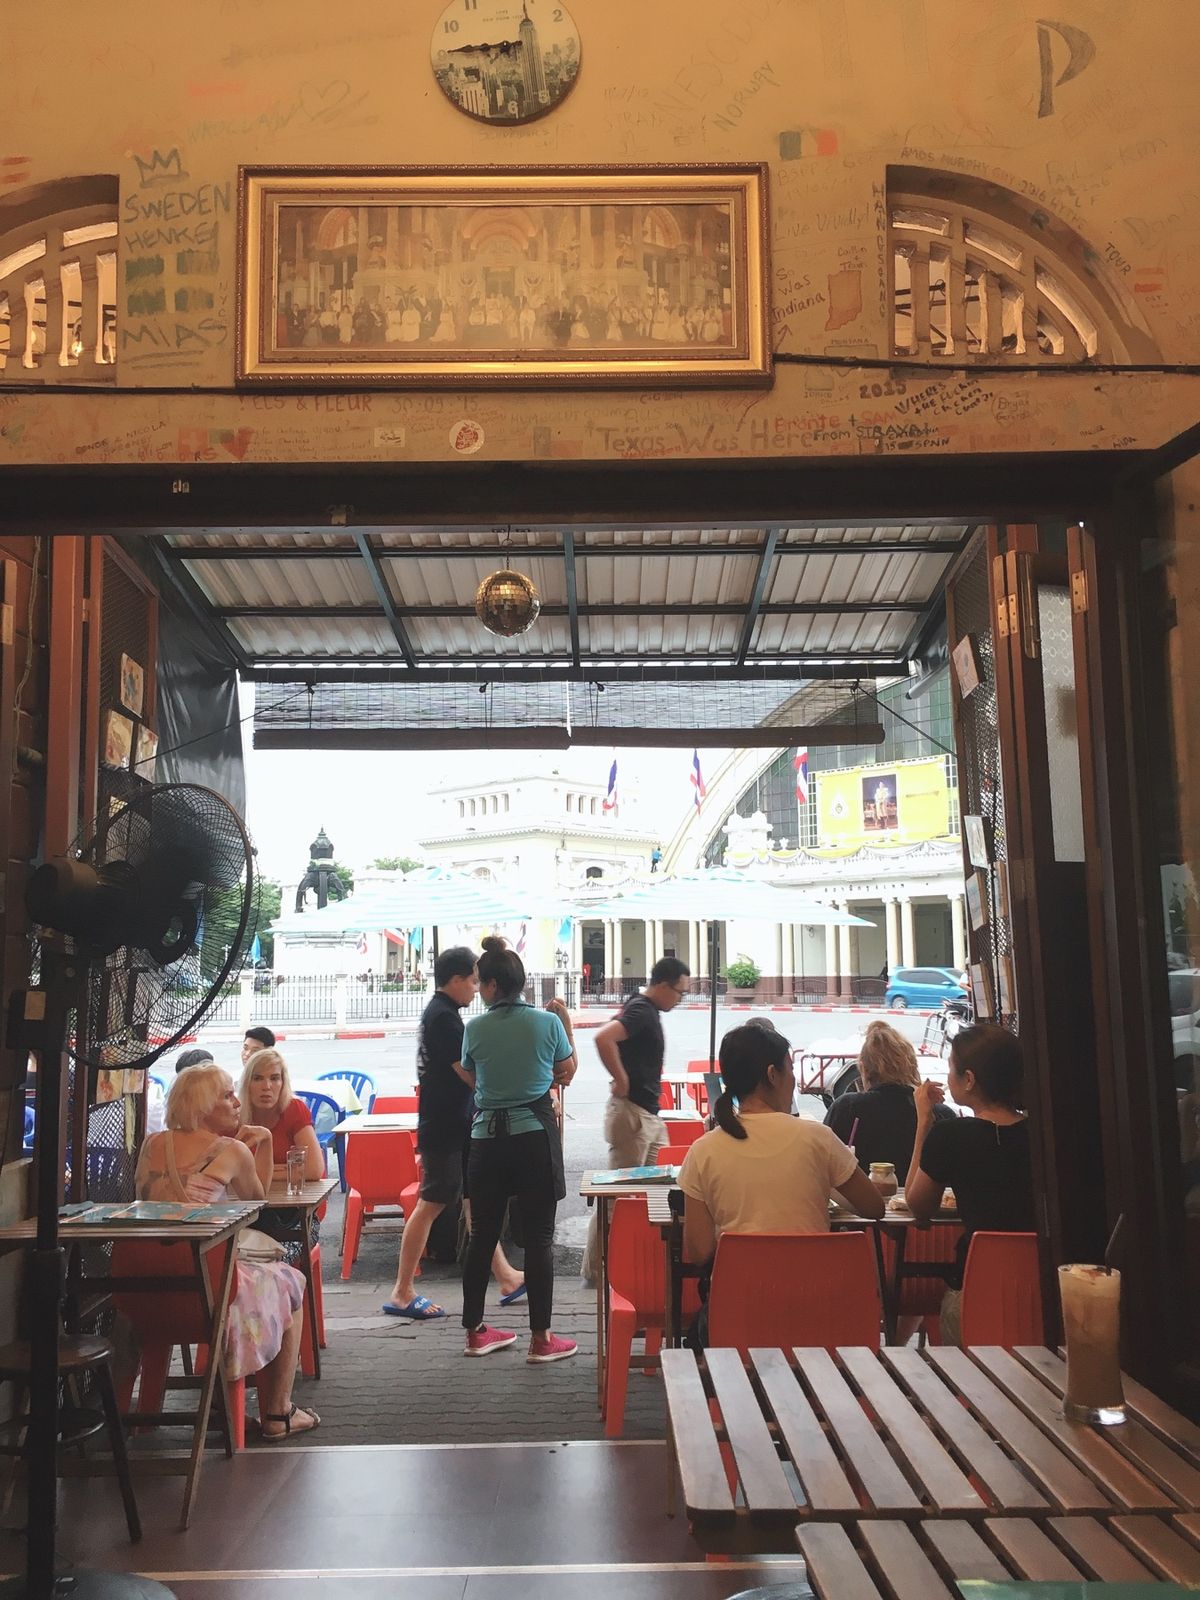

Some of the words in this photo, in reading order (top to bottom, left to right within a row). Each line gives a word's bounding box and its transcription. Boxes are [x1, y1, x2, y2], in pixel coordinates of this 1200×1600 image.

[444, 20, 459, 33] 10
[552, 9, 563, 22] 2
[124, 182, 230, 223] SWEDEN
[1105, 242, 1132, 276] TOUR
[772, 292, 826, 325] Indiana
[859, 380, 907, 399] 2015
[315, 395, 372, 412] FLEUR
[596, 427, 665, 452] Texas
[751, 418, 812, 449] Here
